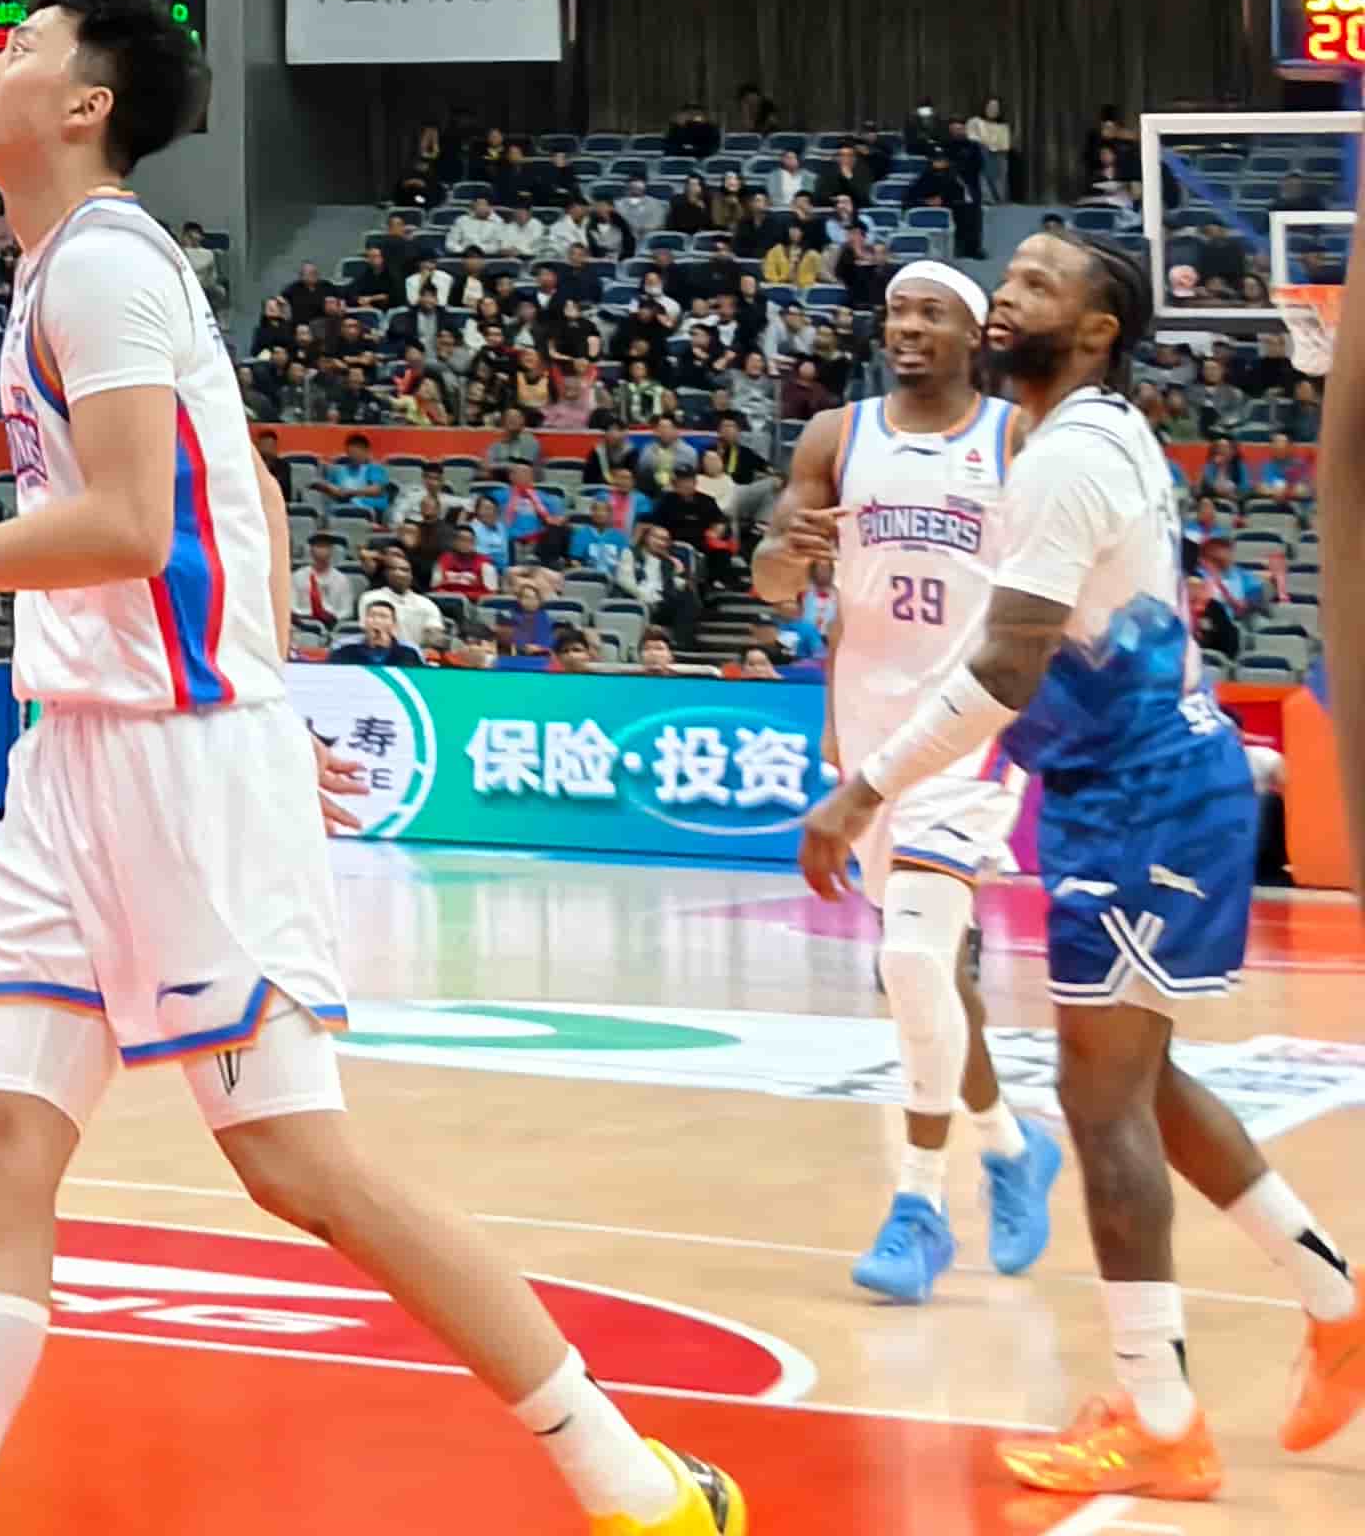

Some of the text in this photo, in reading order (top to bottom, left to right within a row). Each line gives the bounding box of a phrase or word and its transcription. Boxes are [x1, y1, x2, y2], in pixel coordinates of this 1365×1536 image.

[172, 4, 189, 22] 0
[857, 498, 983, 555] PIONEERS
[890, 575, 945, 626] 29
